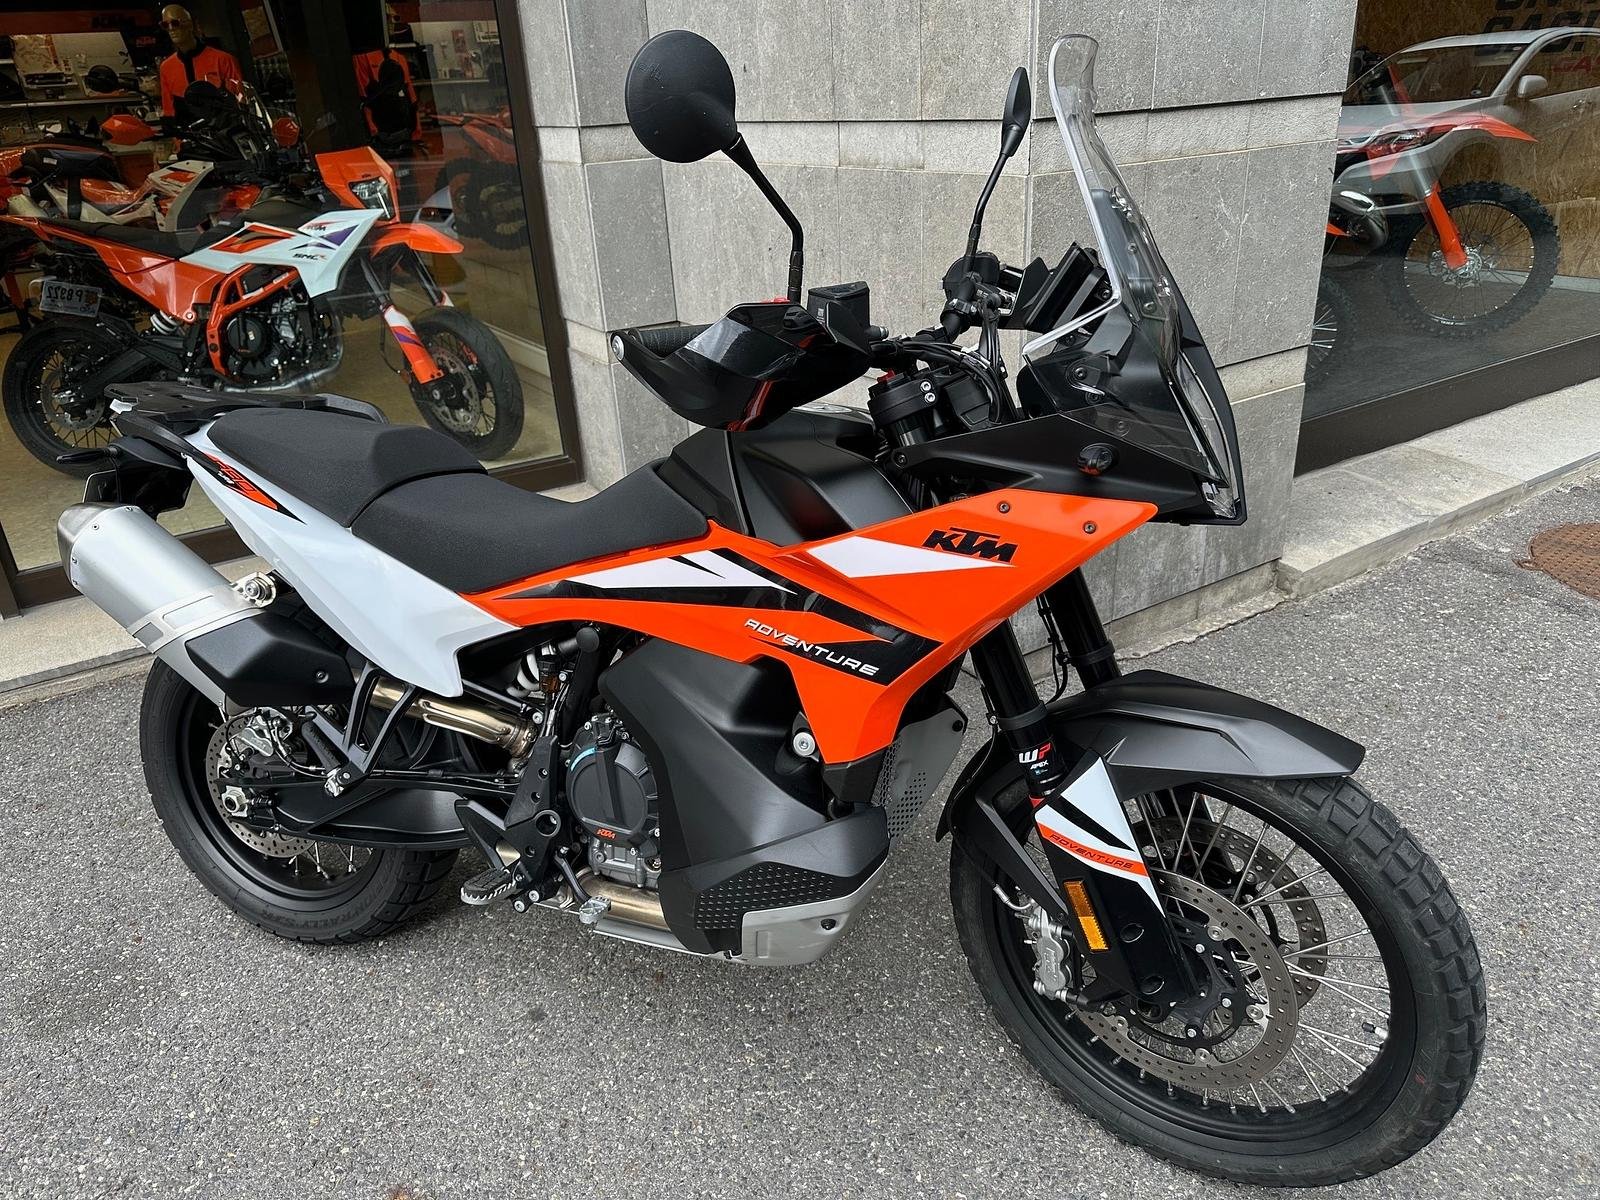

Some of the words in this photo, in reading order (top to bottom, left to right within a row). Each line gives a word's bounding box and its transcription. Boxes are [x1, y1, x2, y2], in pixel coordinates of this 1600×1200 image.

[920, 526, 1019, 564] KTM
[744, 618, 880, 677] ADVENTURE
[1018, 741, 1052, 764] WP
[597, 828, 616, 840] KTM
[1049, 833, 1134, 870] ADVENTURE
